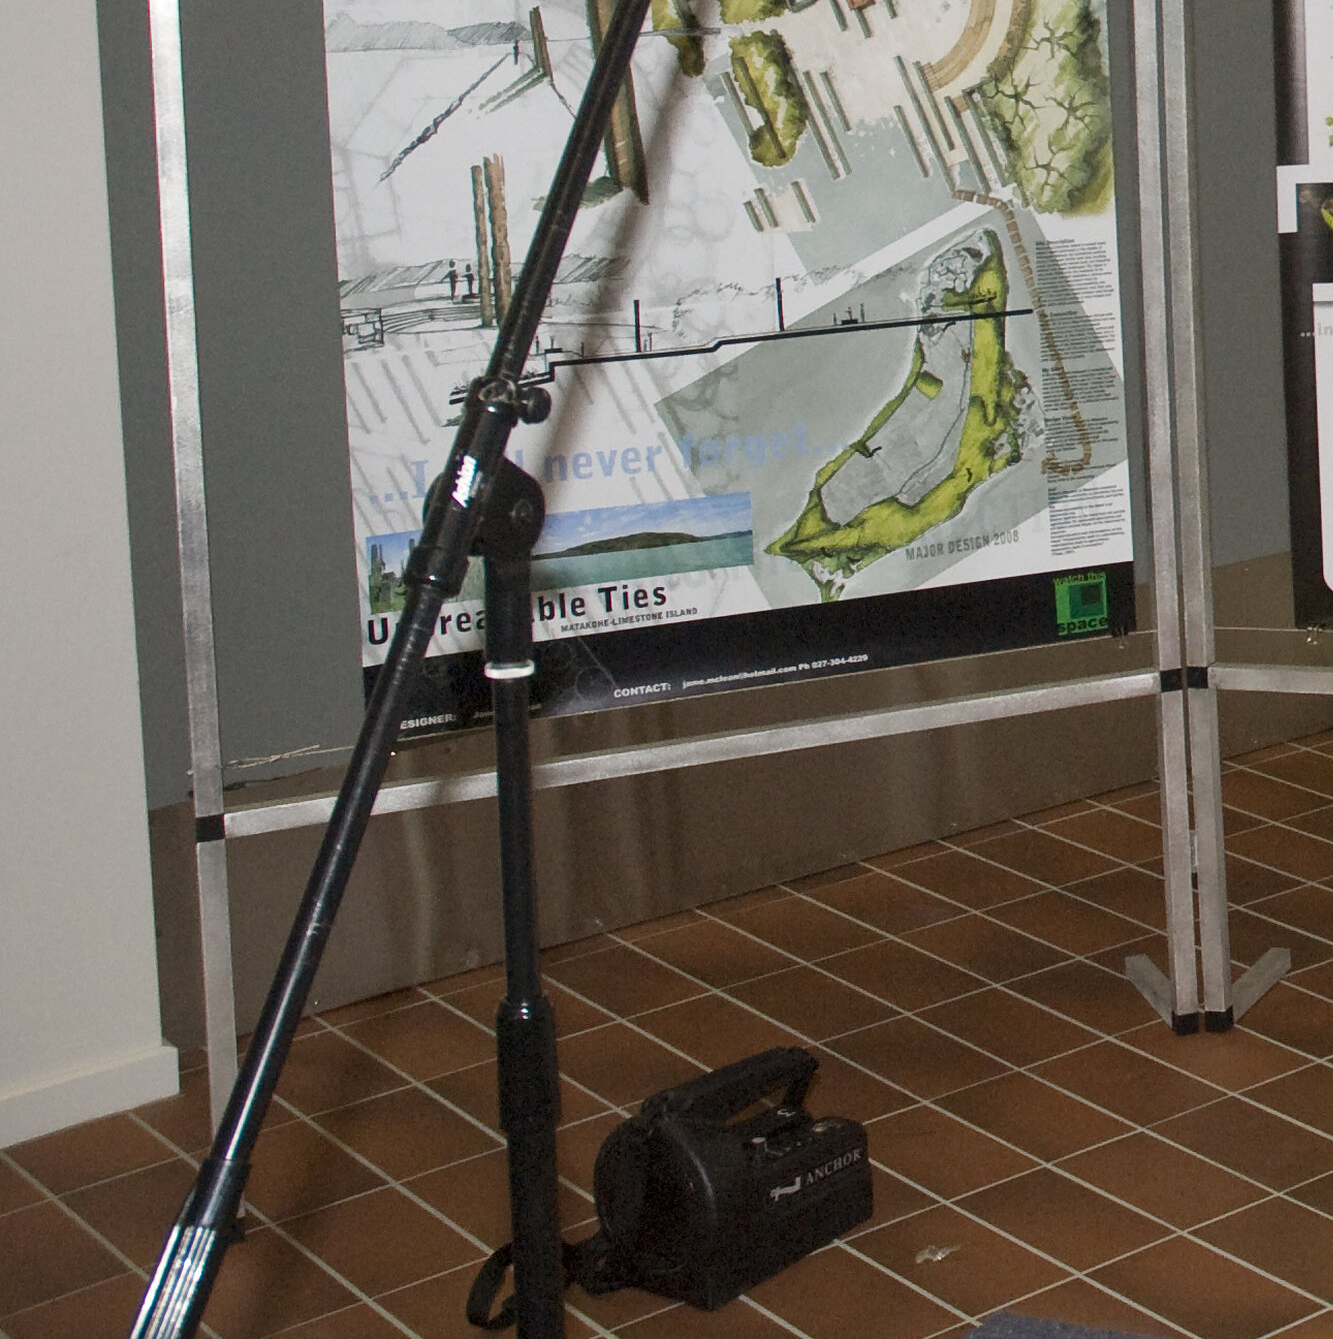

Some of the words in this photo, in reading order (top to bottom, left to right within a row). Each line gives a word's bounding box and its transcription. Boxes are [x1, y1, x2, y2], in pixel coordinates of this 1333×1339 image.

[544, 443, 662, 483] never
[906, 544, 944, 560] MAJOR
[949, 535, 989, 553] DESIGN
[994, 530, 1019, 545] 2008
[598, 587, 667, 613] Ties
[665, 607, 697, 618] ISLAND
[1058, 617, 1108, 633] space
[614, 683, 671, 698] CONTACT:
[805, 1148, 862, 1185] ANCHOR
